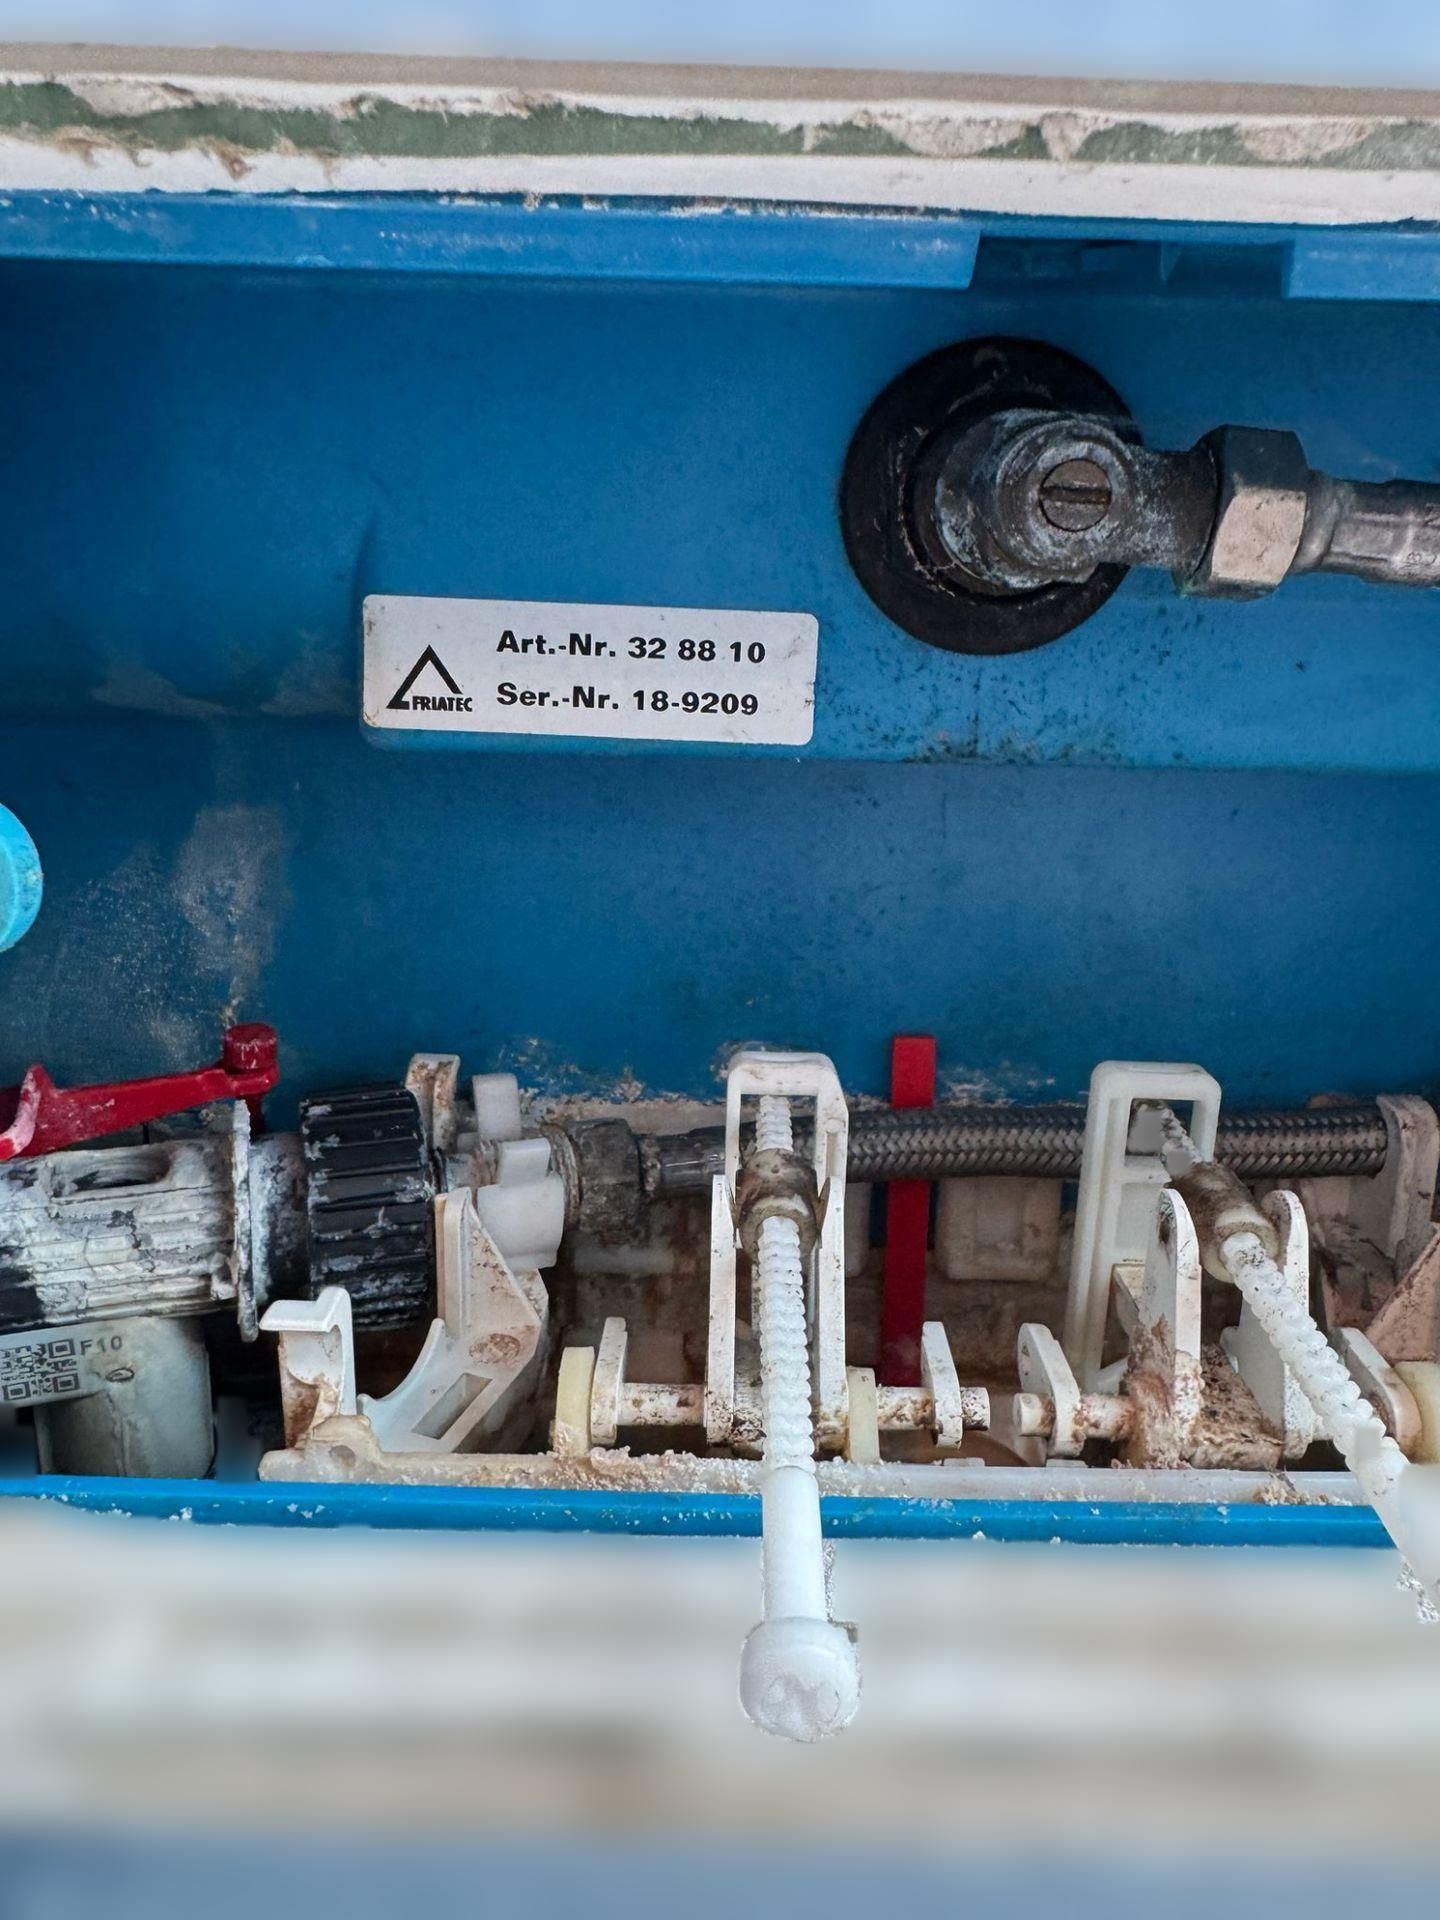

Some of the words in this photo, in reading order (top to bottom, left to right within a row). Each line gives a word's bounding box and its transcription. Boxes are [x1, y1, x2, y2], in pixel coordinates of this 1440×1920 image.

[496, 630, 616, 658] Art.-Nr.
[627, 636, 667, 660] 32
[677, 638, 716, 662] 88
[729, 641, 766, 664] 10
[412, 695, 473, 712] FRIATEC
[496, 682, 619, 710] Ser.-Nr.
[633, 689, 759, 716] 18-9209
[80, 1335, 122, 1356] F10
